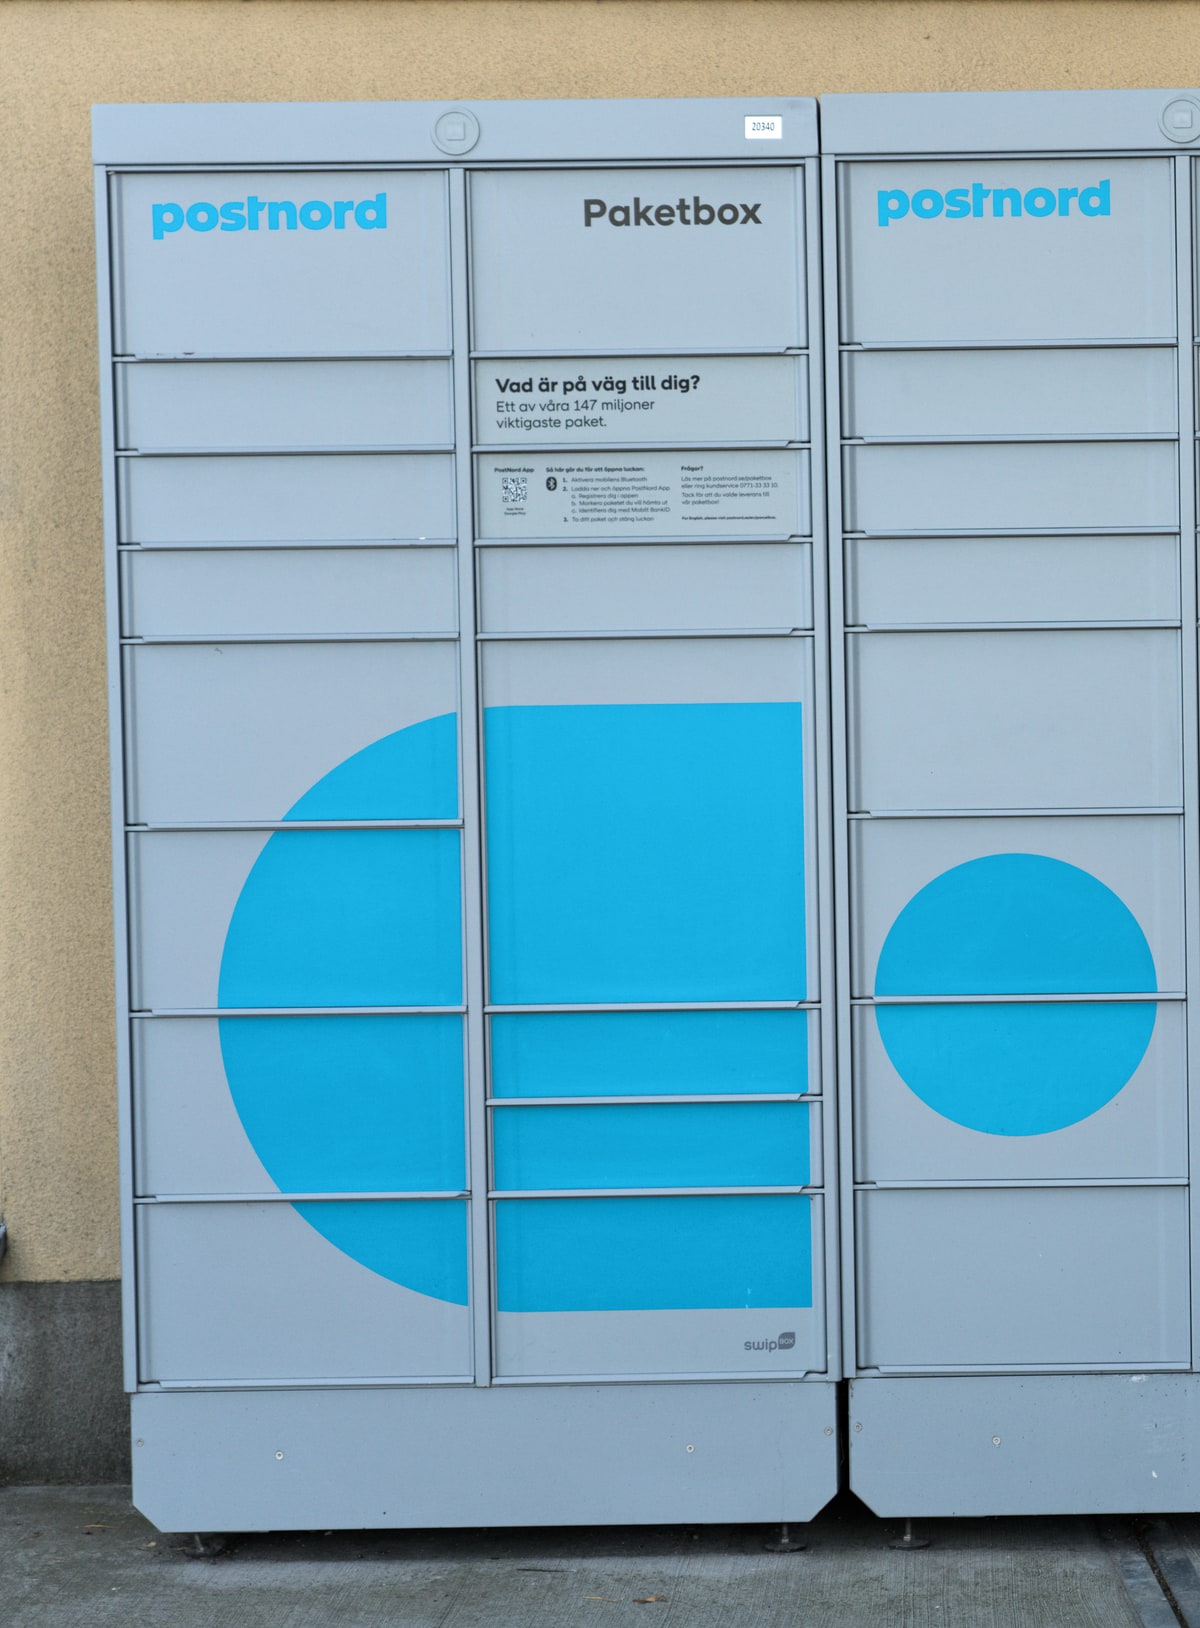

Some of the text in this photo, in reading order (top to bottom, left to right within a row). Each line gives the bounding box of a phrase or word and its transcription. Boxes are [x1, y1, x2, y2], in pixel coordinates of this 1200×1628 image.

[752, 122, 774, 131] 20340
[878, 179, 1110, 226] postnord
[152, 192, 387, 240] postnord
[584, 196, 762, 227] Paketbox
[495, 375, 700, 395] Vad är på väg till dig?
[497, 399, 655, 412] Ett av våra 147 miljoner
[496, 416, 607, 430] viktigaste paket.
[744, 1338, 777, 1352] swip
